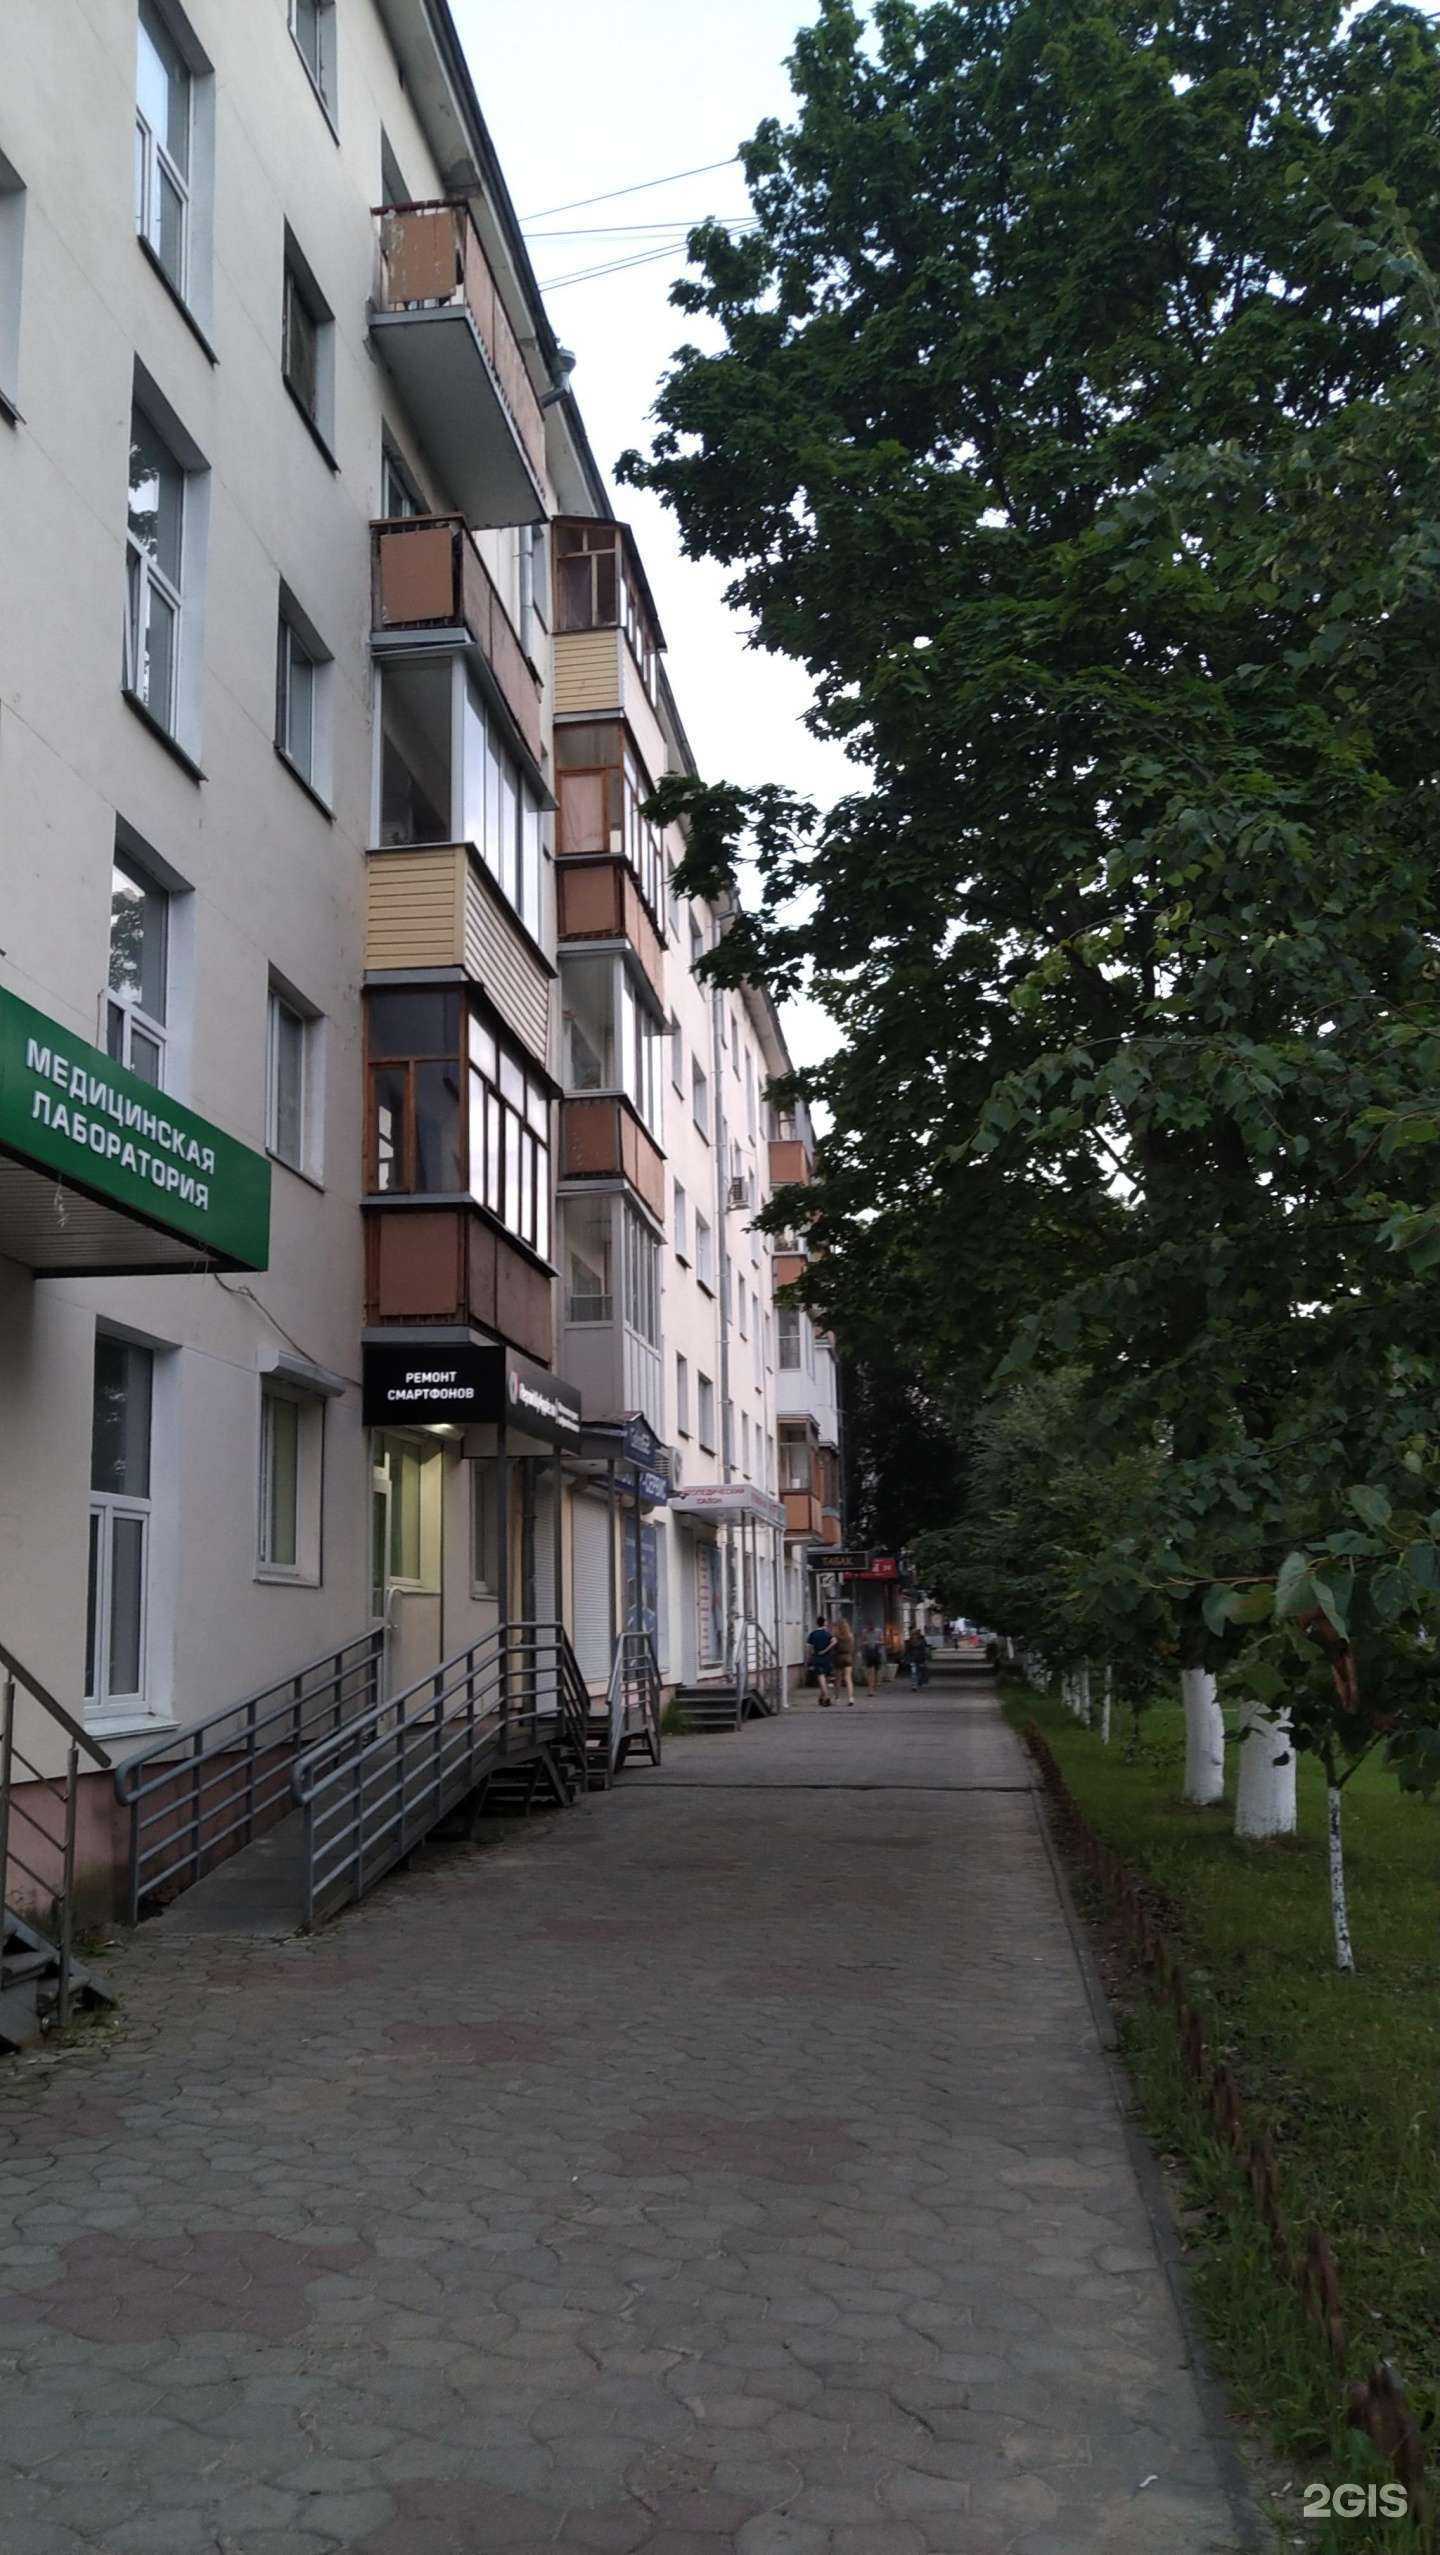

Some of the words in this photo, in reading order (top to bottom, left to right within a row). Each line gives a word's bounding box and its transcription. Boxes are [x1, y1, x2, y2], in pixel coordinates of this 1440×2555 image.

[27, 1038, 215, 1174] МЕДИЦИНСКАЯ
[32, 1091, 209, 1210] ЛАБОРАТОРИЯ
[387, 1387, 475, 1401] СМАРТФОНОВ
[405, 1371, 457, 1384] РЕМОНТ
